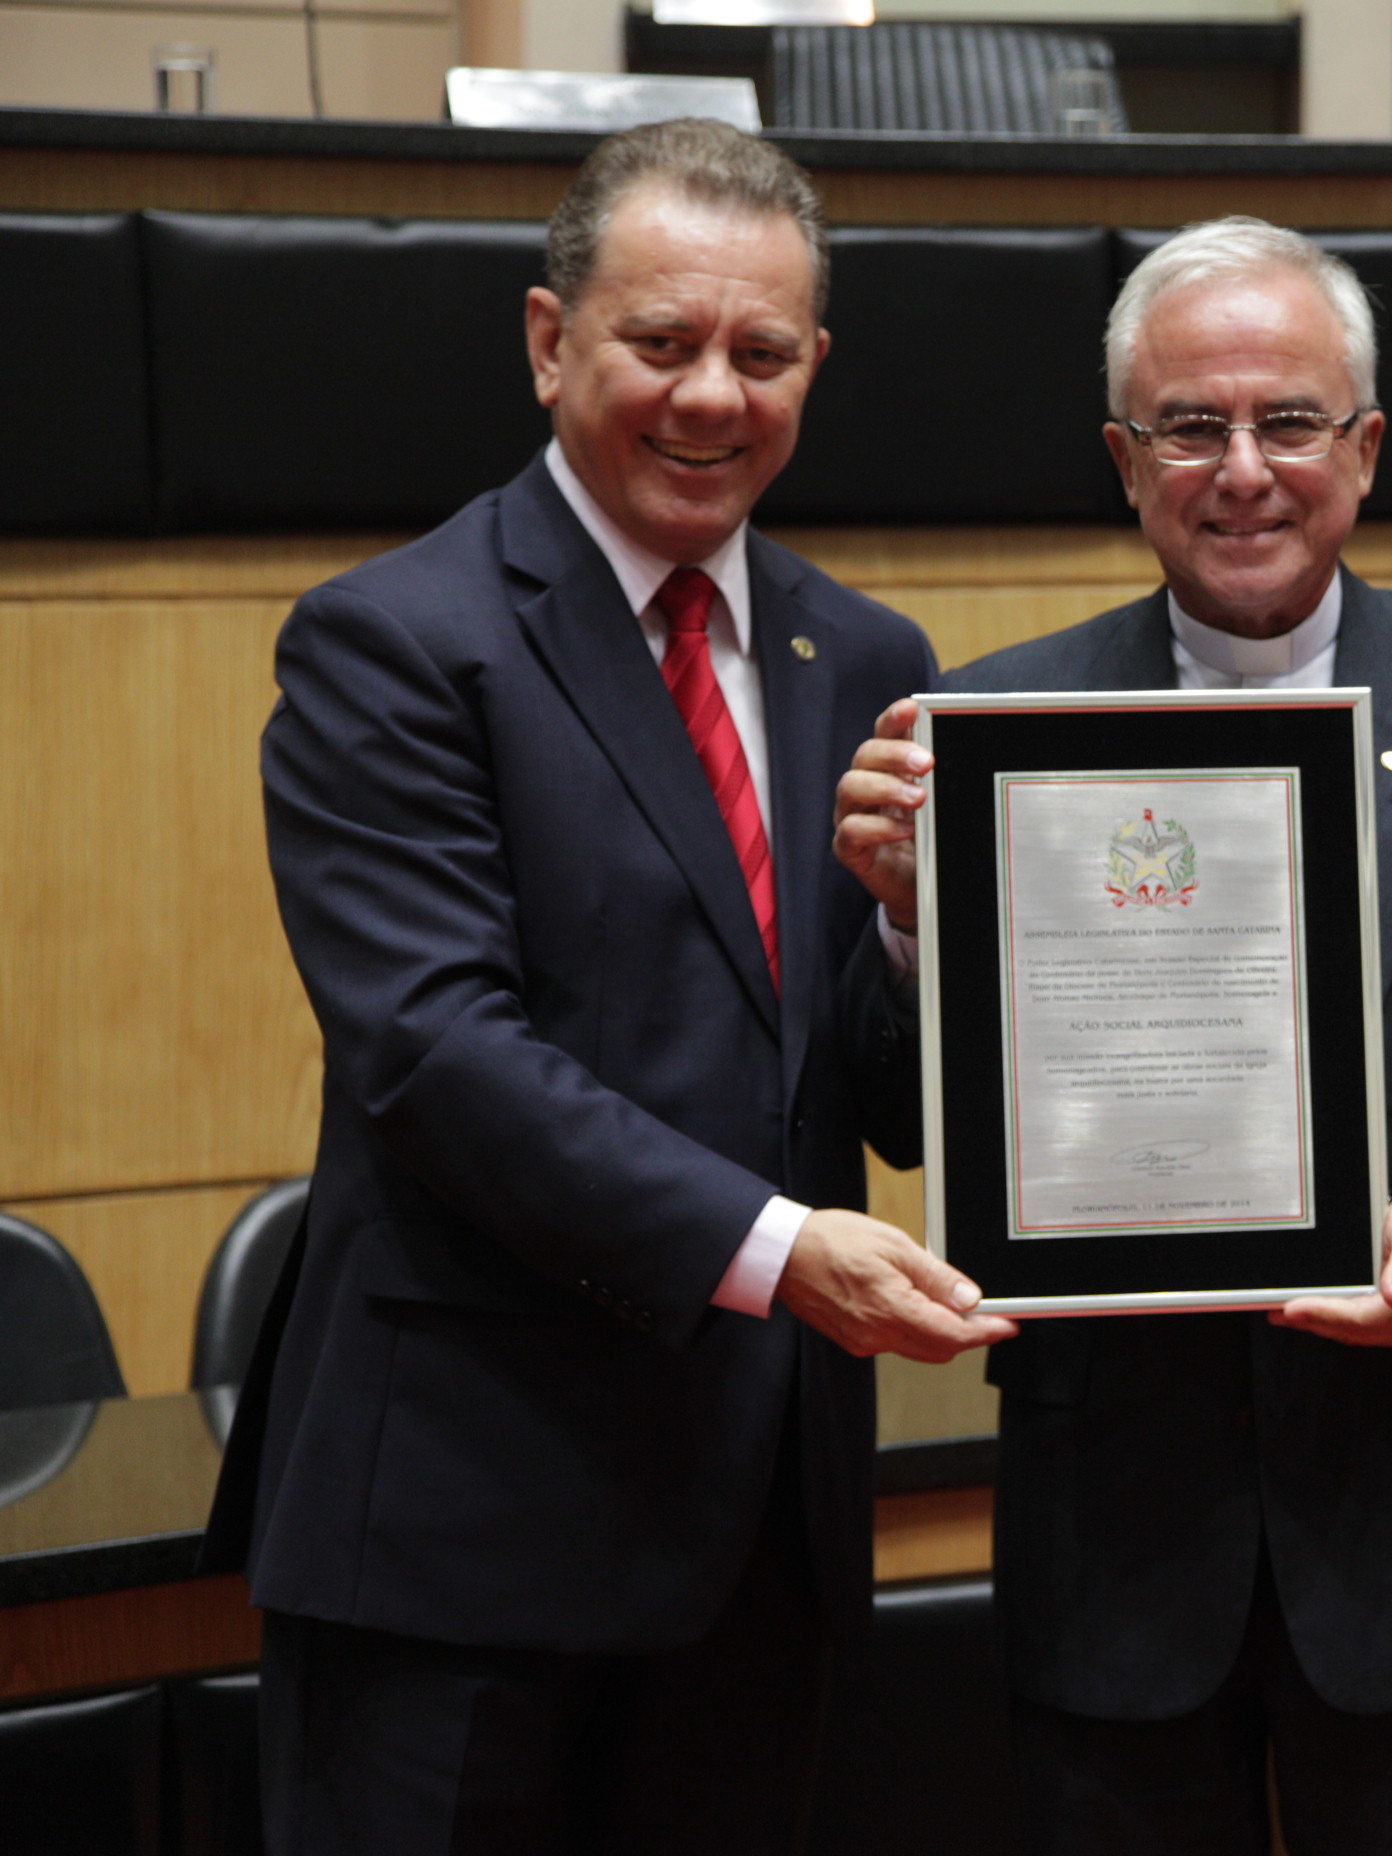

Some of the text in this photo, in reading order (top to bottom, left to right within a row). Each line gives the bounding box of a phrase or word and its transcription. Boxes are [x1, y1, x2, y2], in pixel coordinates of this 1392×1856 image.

[1080, 929, 1136, 938] LEGISLATIVA
[1155, 928, 1190, 936] ESTADO
[1206, 927, 1236, 936] SANTA
[1238, 926, 1281, 935] CATARINA
[1070, 1018, 1244, 1032] AÇÃO SOCIAL ARQUIDIOCESANA
